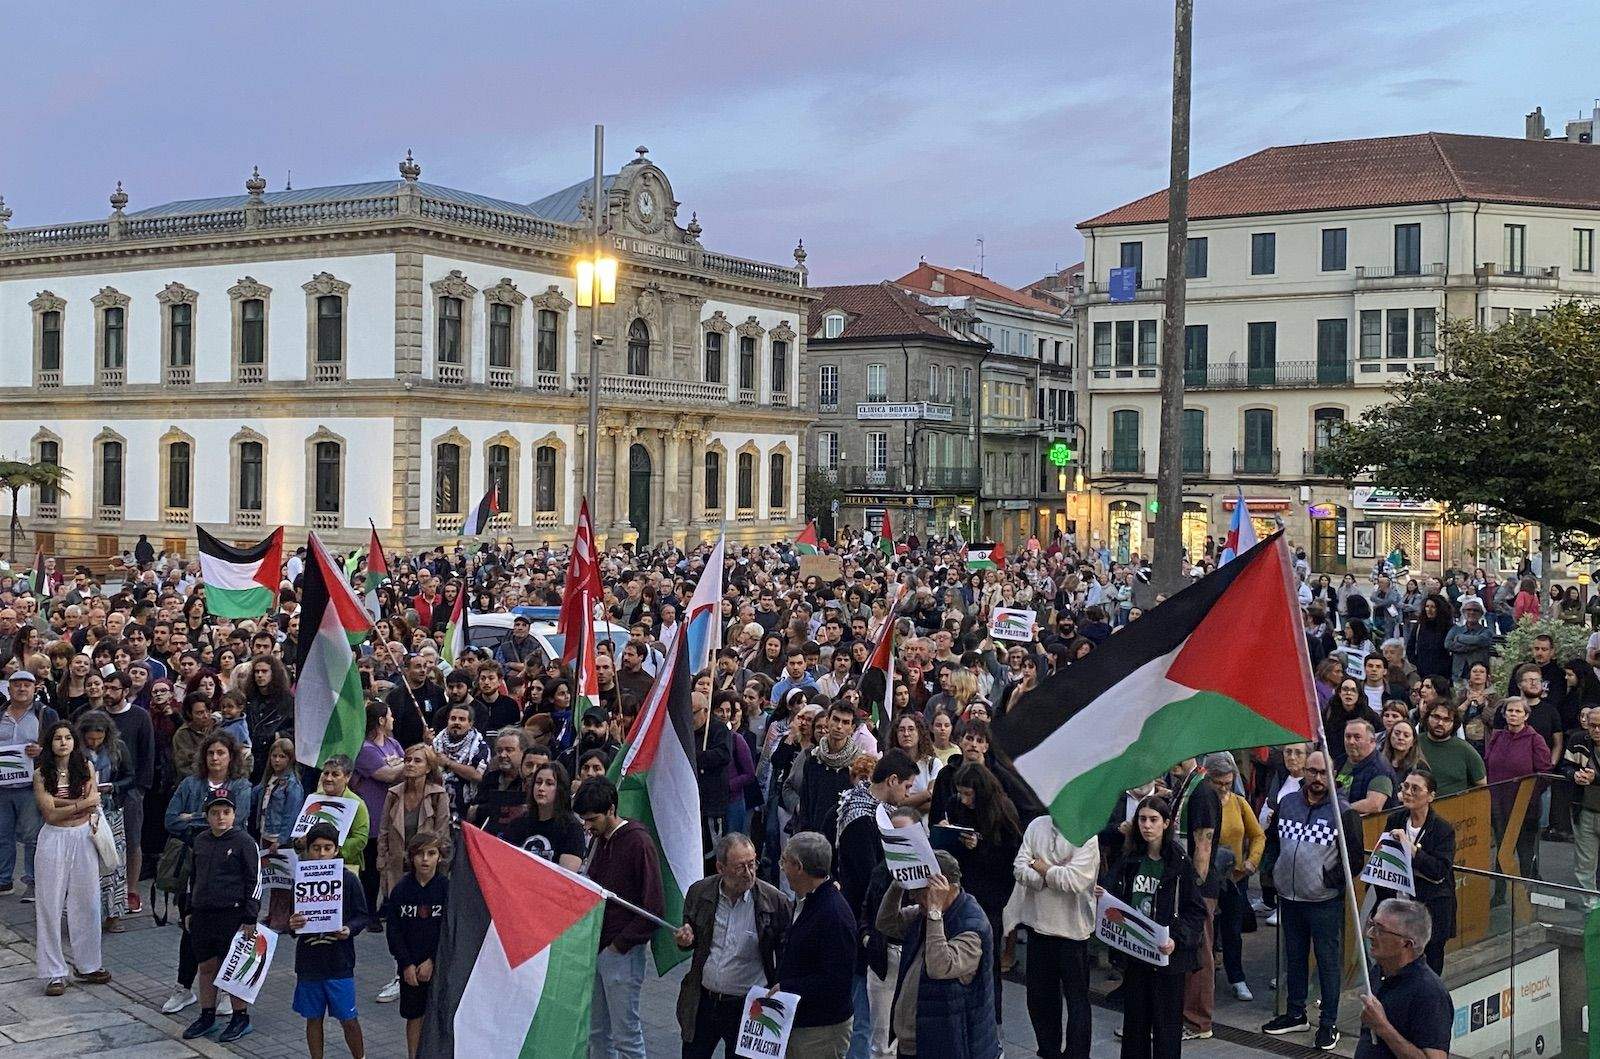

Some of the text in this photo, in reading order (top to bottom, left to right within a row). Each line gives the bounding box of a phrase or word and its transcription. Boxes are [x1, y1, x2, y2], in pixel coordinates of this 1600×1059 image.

[0, 771, 29, 781] ALESTINA
[1372, 868, 1411, 887] PALESTINA
[296, 880, 341, 897] STOP
[1101, 918, 1127, 939] GALIZA
[1100, 927, 1161, 962] CON PALESTINA
[222, 941, 246, 982] PALESTINA
[1520, 976, 1551, 998] telpark
[744, 1020, 764, 1037] GALIZA
[740, 1034, 781, 1056] CON PALESTINA
